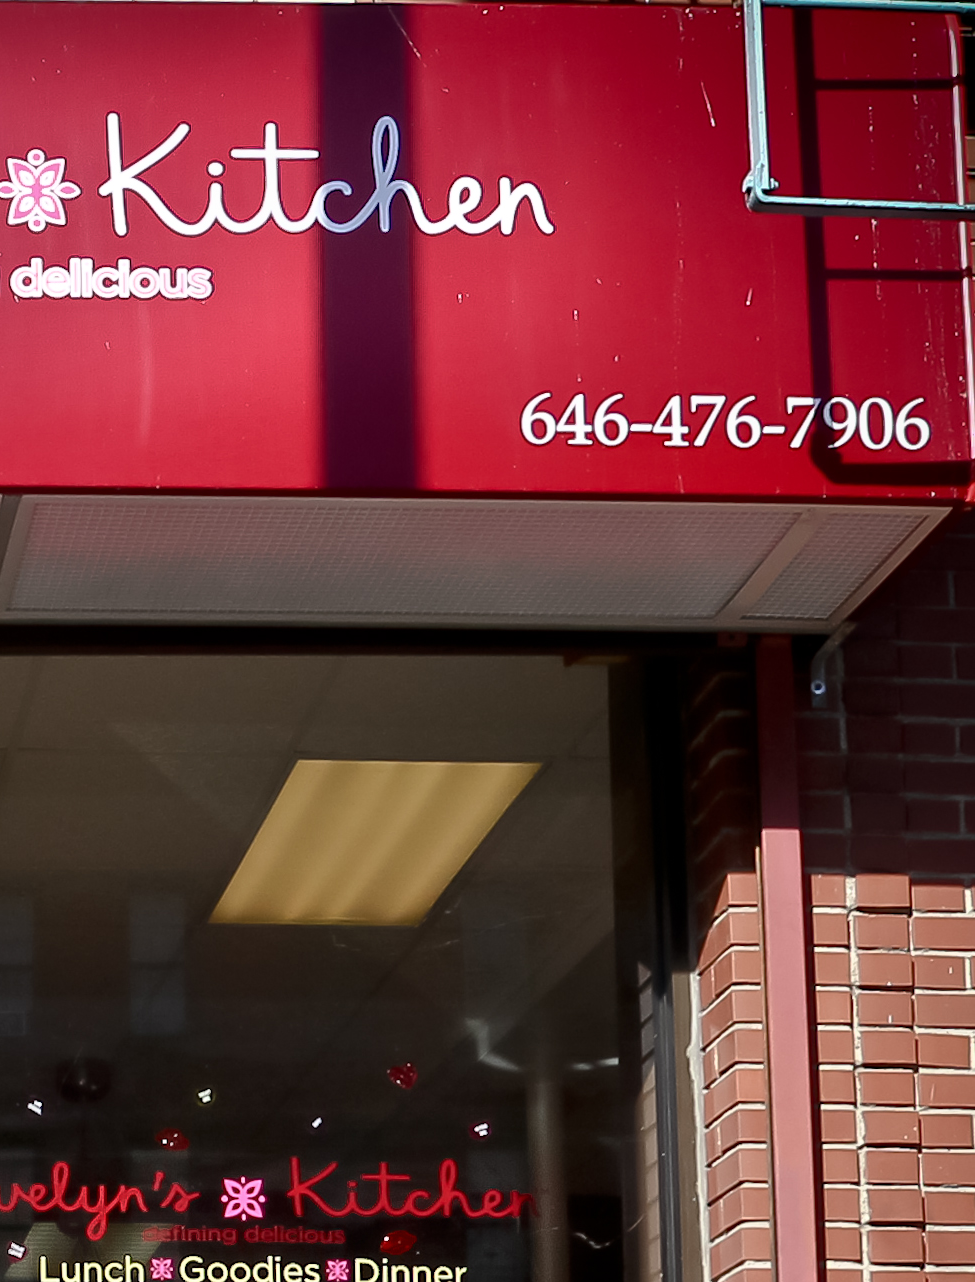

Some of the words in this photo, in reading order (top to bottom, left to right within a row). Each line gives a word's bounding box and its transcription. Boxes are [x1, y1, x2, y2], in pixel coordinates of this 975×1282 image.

[98, 112, 556, 237] Kitchen
[10, 256, 214, 300] delicious
[520, 392, 932, 453] 646-476-7906
[286, 1155, 540, 1218] Kitchen
[141, 1224, 238, 1246] defining
[243, 1225, 347, 1245] delicious
